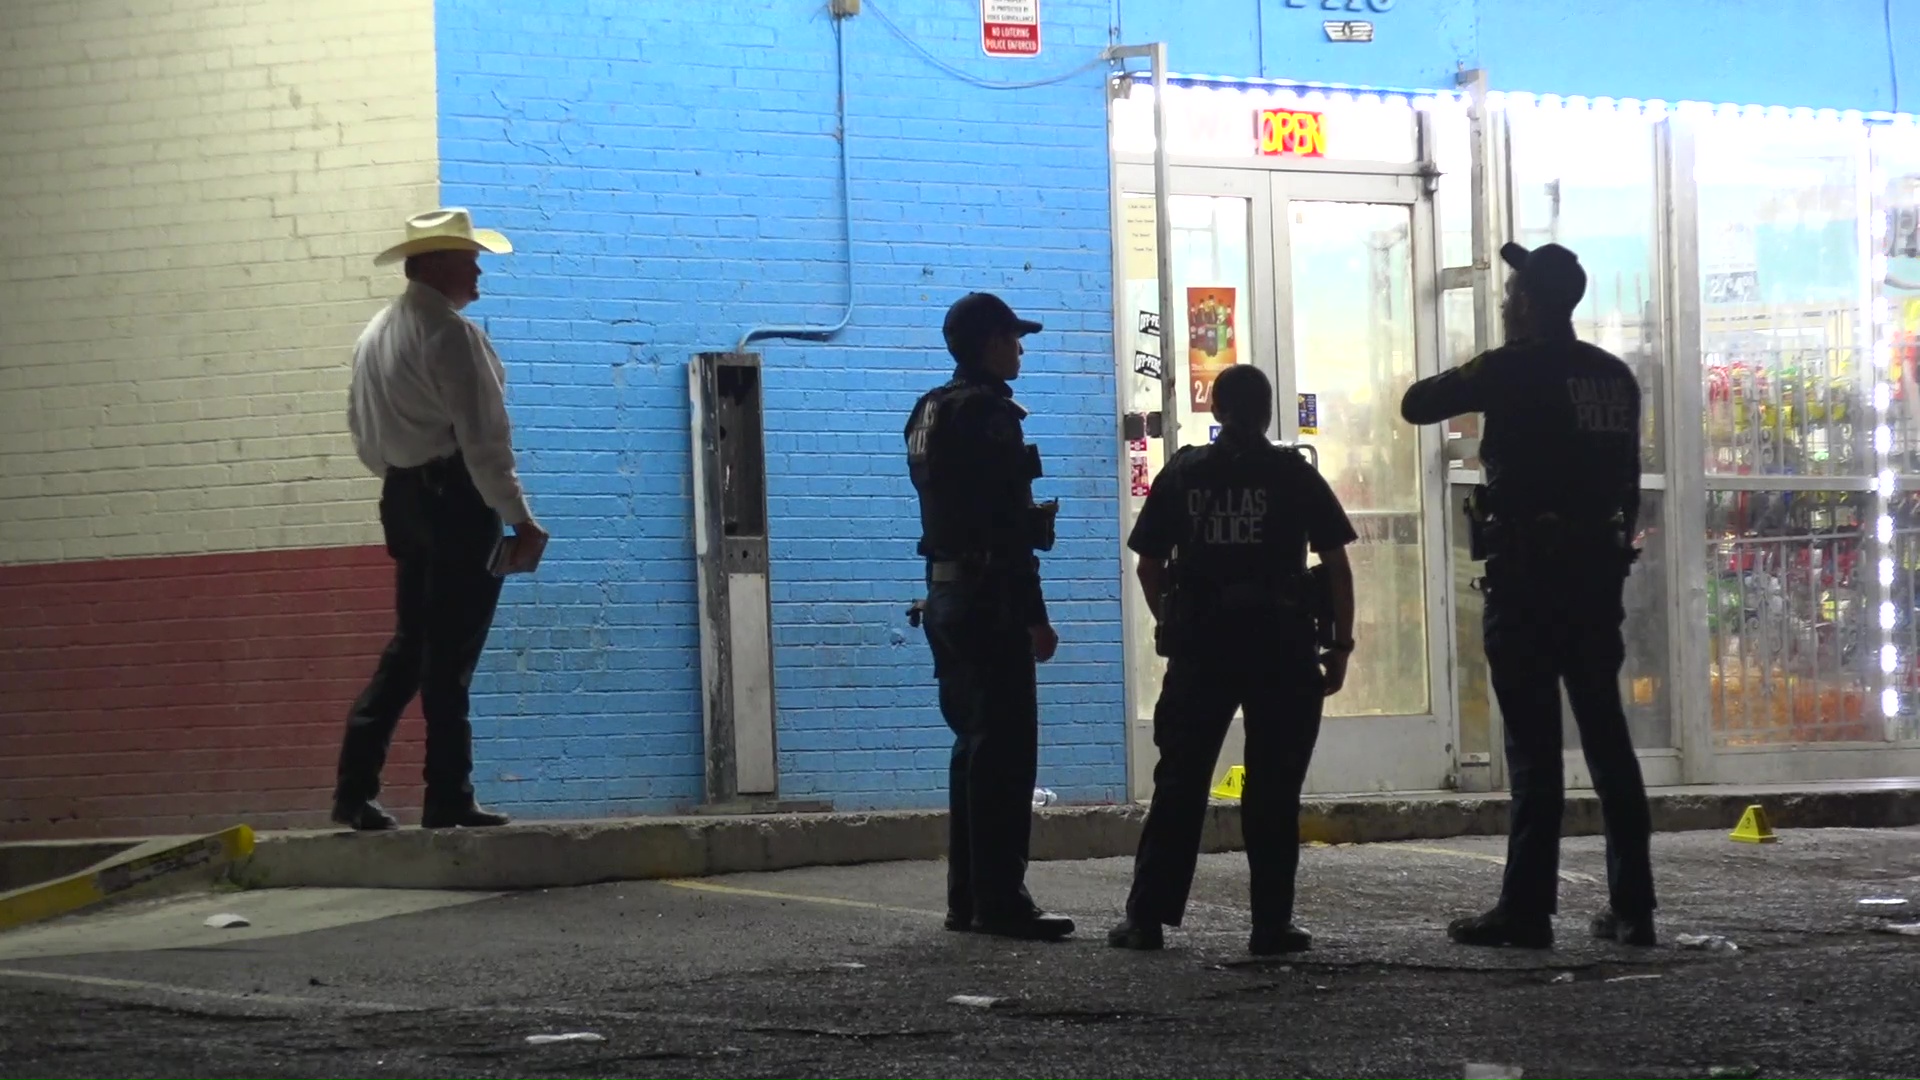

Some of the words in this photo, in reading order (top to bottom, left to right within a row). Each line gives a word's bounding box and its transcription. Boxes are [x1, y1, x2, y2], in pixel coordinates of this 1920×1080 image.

[992, 27, 1000, 37] NO
[1001, 27, 1030, 38] LOITERING
[985, 38, 1006, 50] POLICE
[1007, 39, 1037, 51] ENFORCED
[1262, 111, 1326, 155] OPEN
[1576, 404, 1631, 432] POLICE
